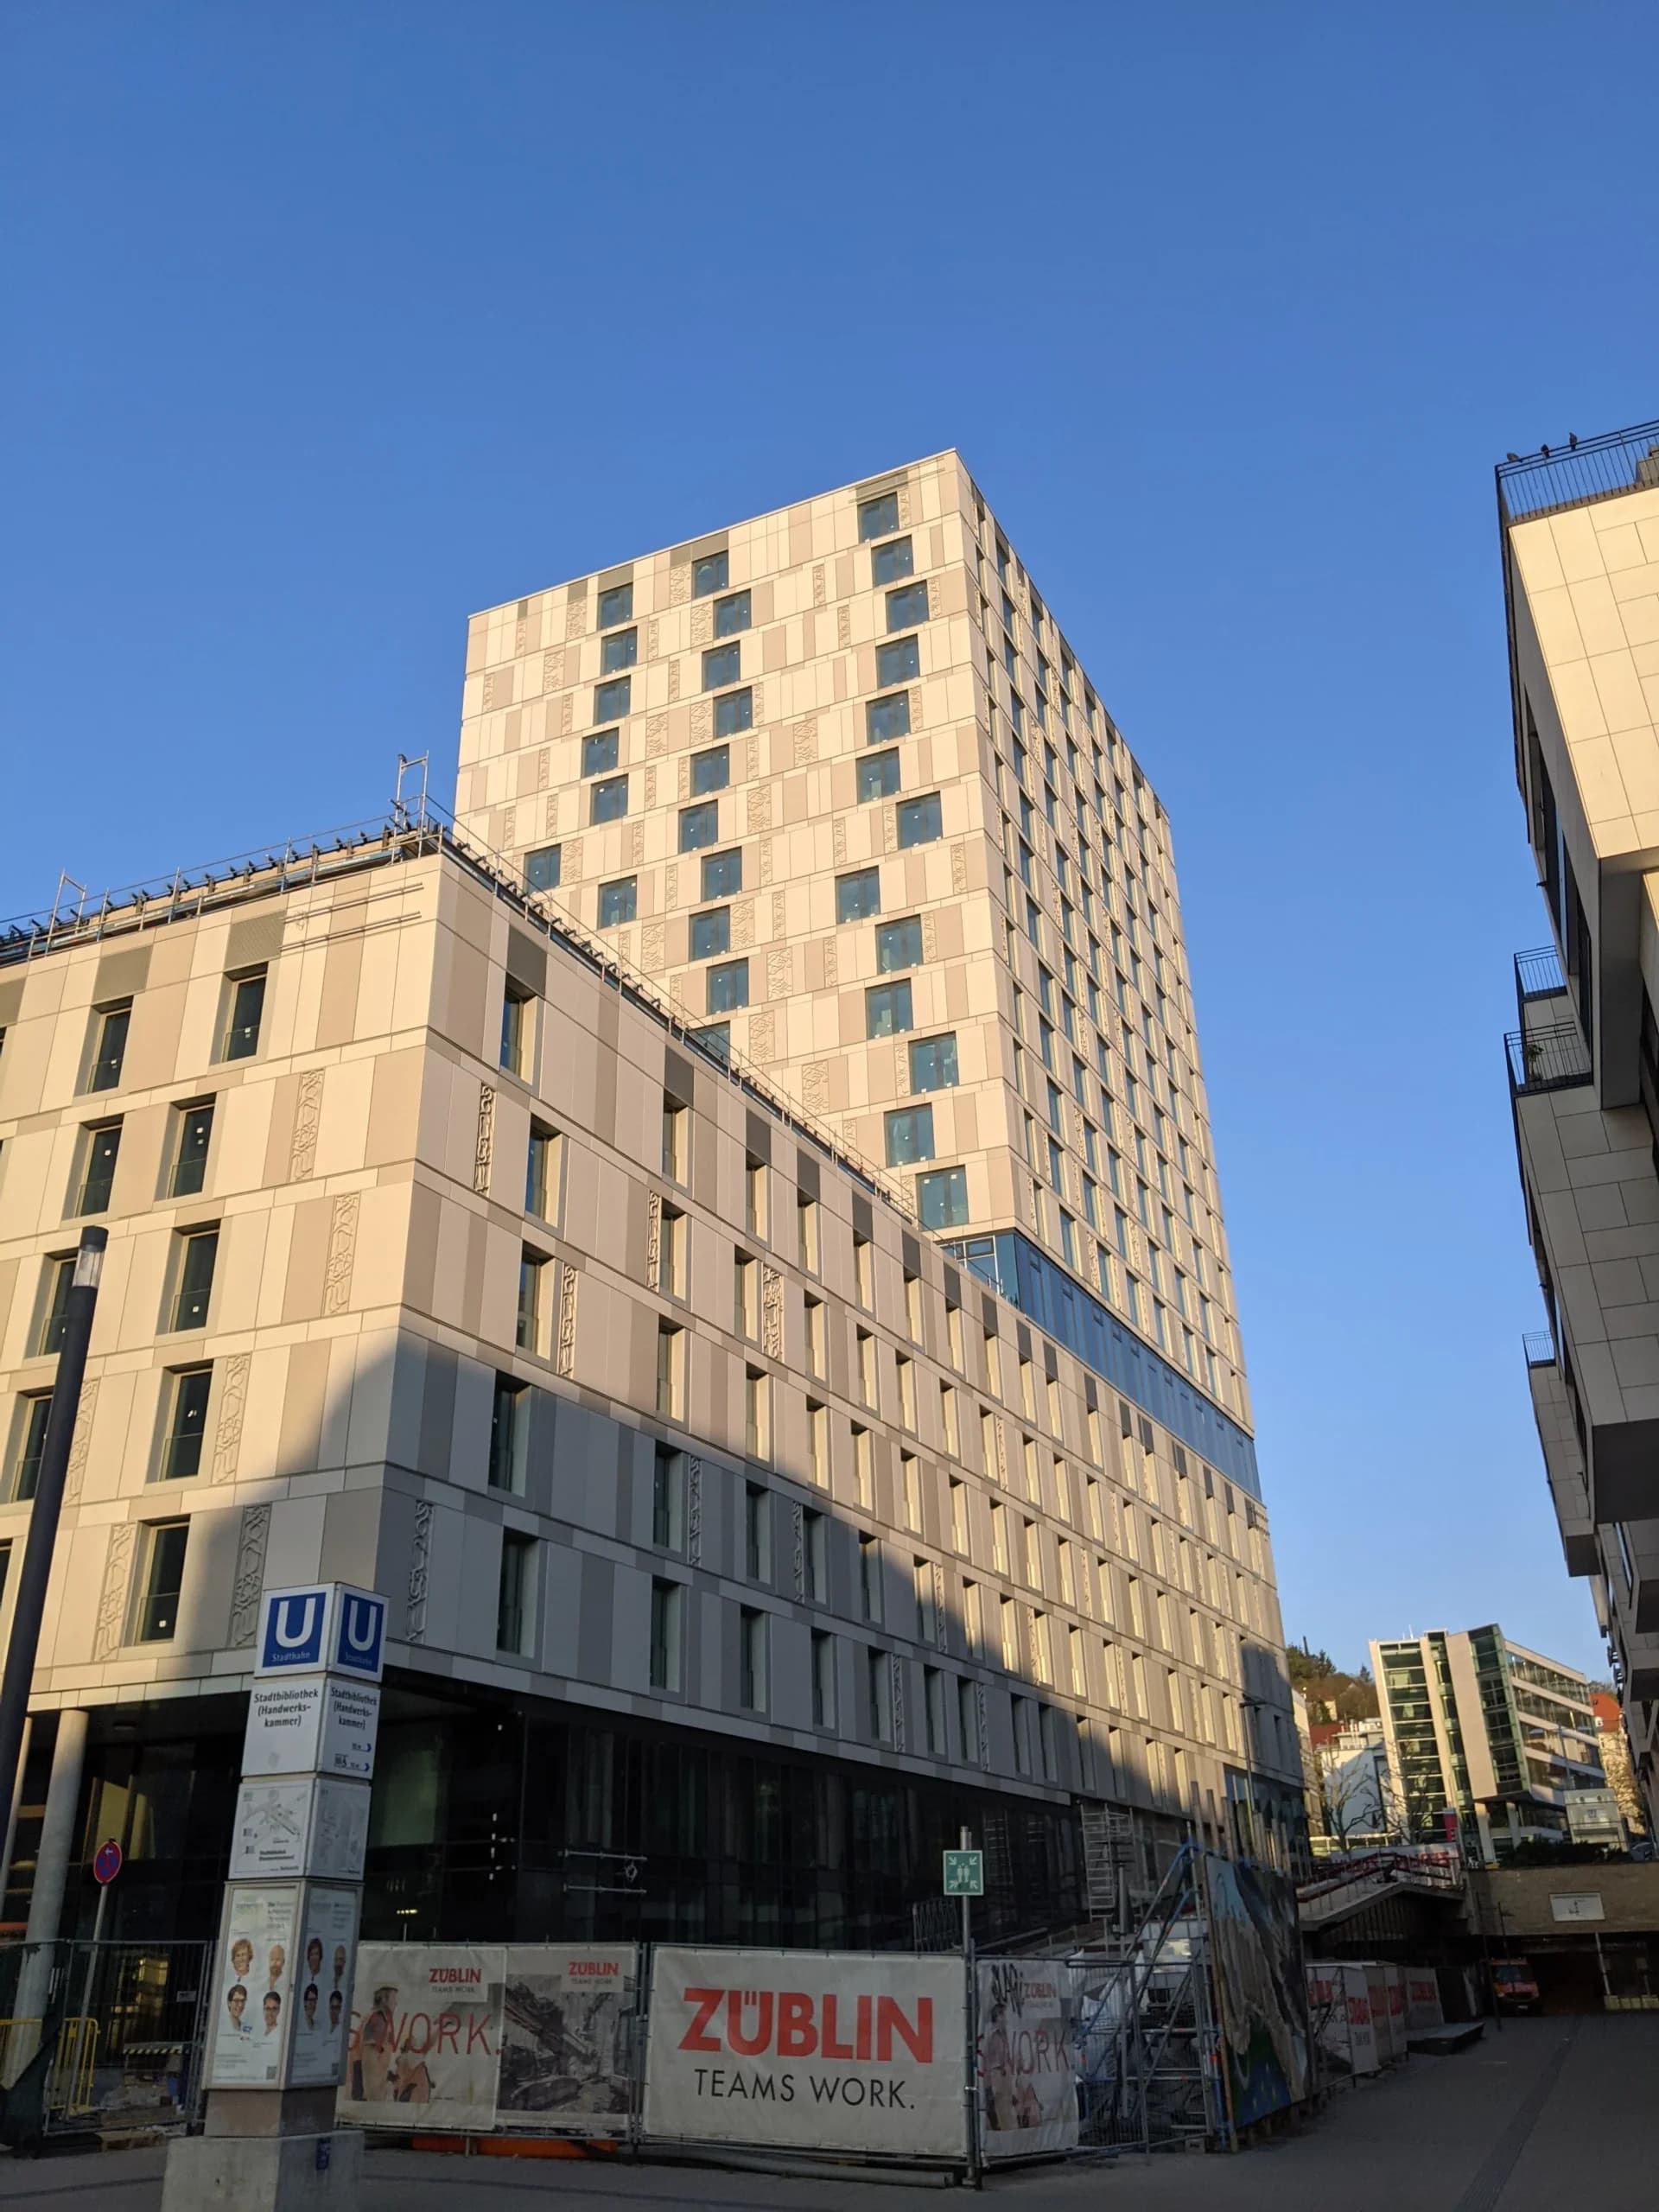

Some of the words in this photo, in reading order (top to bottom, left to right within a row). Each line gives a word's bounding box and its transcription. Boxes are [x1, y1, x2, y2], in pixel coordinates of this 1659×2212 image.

[276, 1598, 316, 1648] U
[348, 1599, 378, 1651] U
[254, 1688, 318, 1703] Stadtbibliothek
[257, 1703, 311, 1717] (Handwerks-
[264, 1715, 302, 1727] kammer)
[429, 1968, 482, 1984] ZÜBLIN
[677, 1987, 932, 2063] ZÜBLIN
[695, 2069, 795, 2102] TEAMS
[810, 2075, 915, 2109] WORK.
